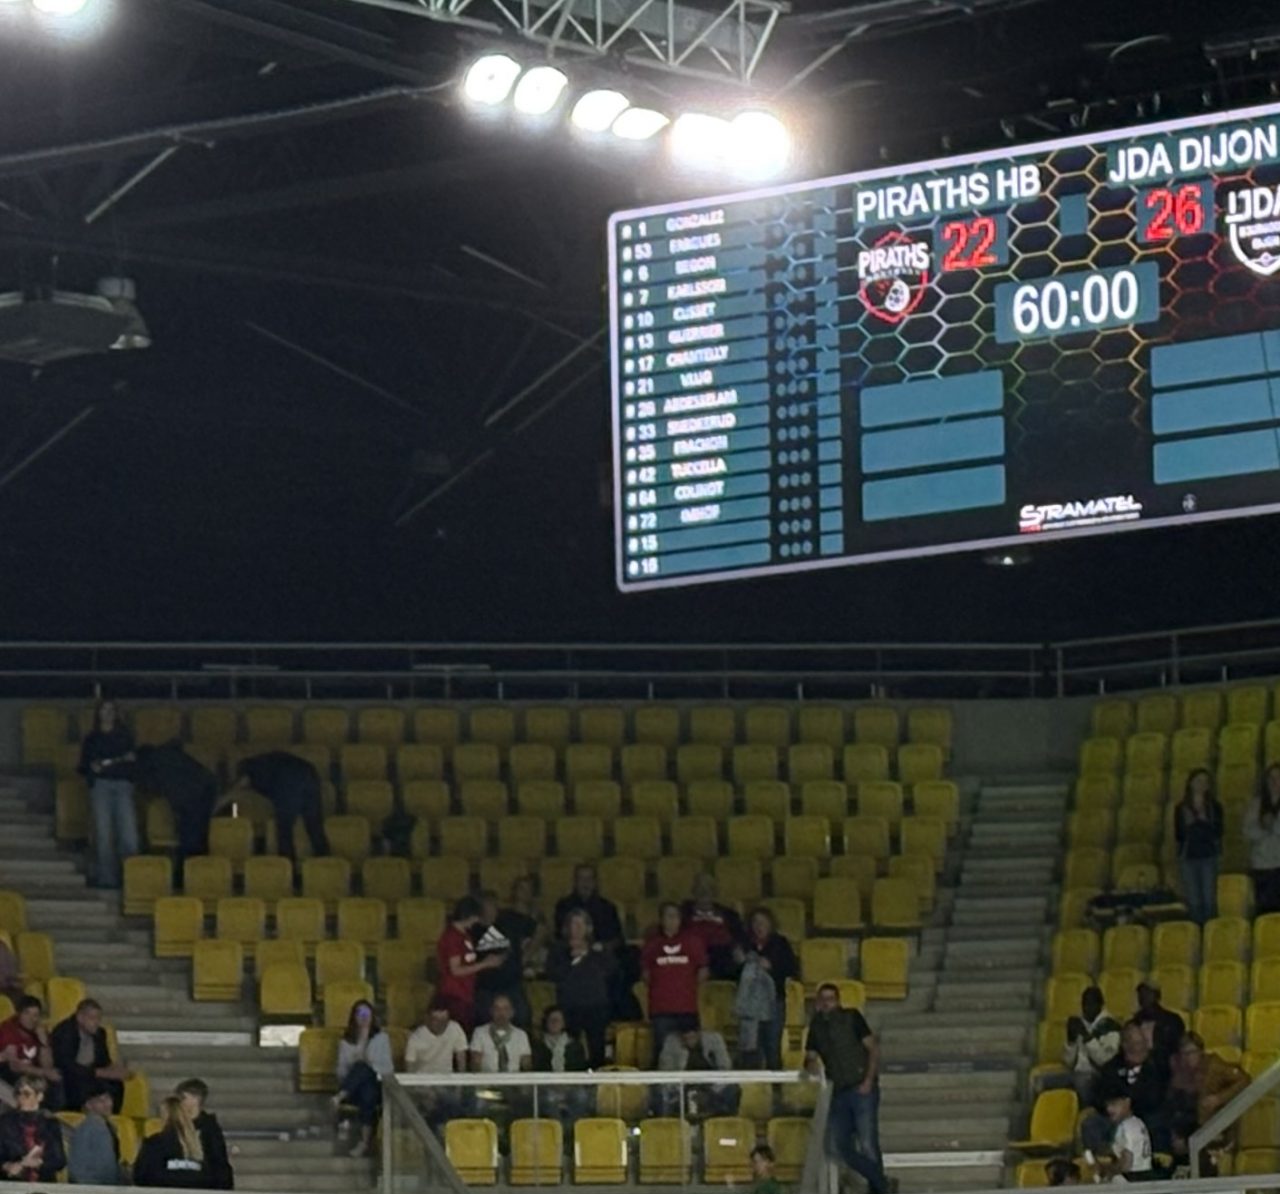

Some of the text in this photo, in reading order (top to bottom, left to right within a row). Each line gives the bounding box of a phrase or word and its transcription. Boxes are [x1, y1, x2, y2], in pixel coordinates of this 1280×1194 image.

[1109, 124, 1278, 184] JDA DIJON
[857, 164, 1042, 223] PIRATHS HB
[1144, 186, 1205, 242] 26
[858, 242, 930, 279] PIRATHS
[940, 217, 997, 271] 22
[1012, 270, 1139, 334] 60:00
[1018, 494, 1143, 525] STRAMATEL
